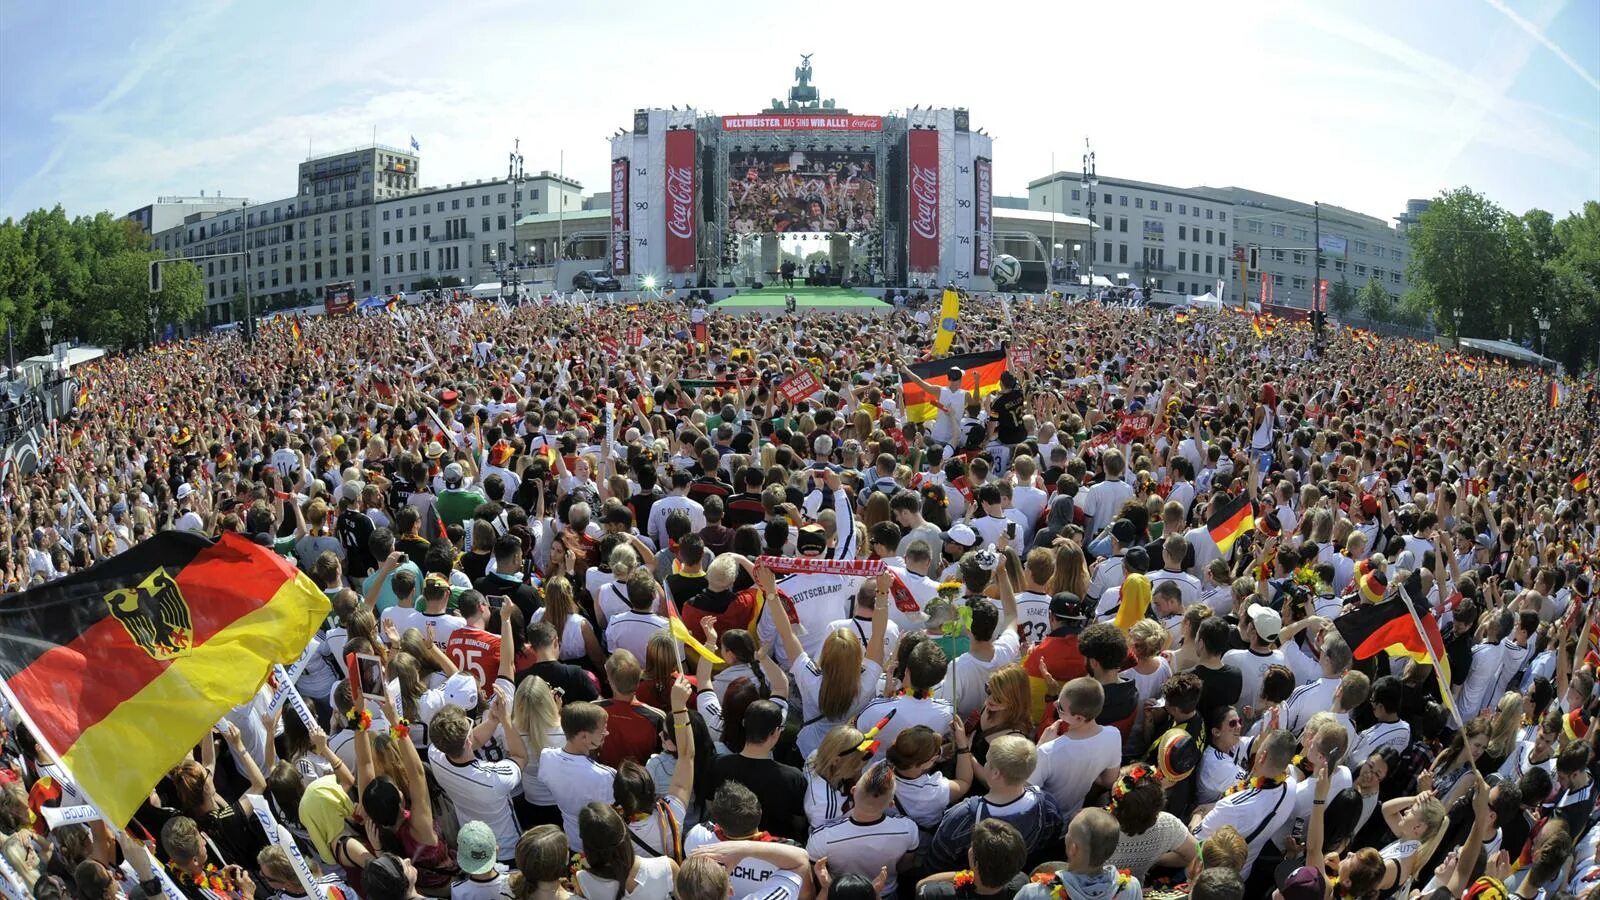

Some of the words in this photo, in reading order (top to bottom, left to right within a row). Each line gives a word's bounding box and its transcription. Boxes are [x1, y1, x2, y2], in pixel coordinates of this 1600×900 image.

[784, 118, 795, 127] DAS
[797, 118, 810, 127] SIND
[811, 118, 825, 127] WIR
[827, 118, 848, 128] ALLE!
[614, 165, 624, 224] JUNGS!
[979, 165, 990, 224] JUNGS!
[791, 584, 842, 605] DEUTSCHLAND
[300, 861, 329, 900] HYUNDA
